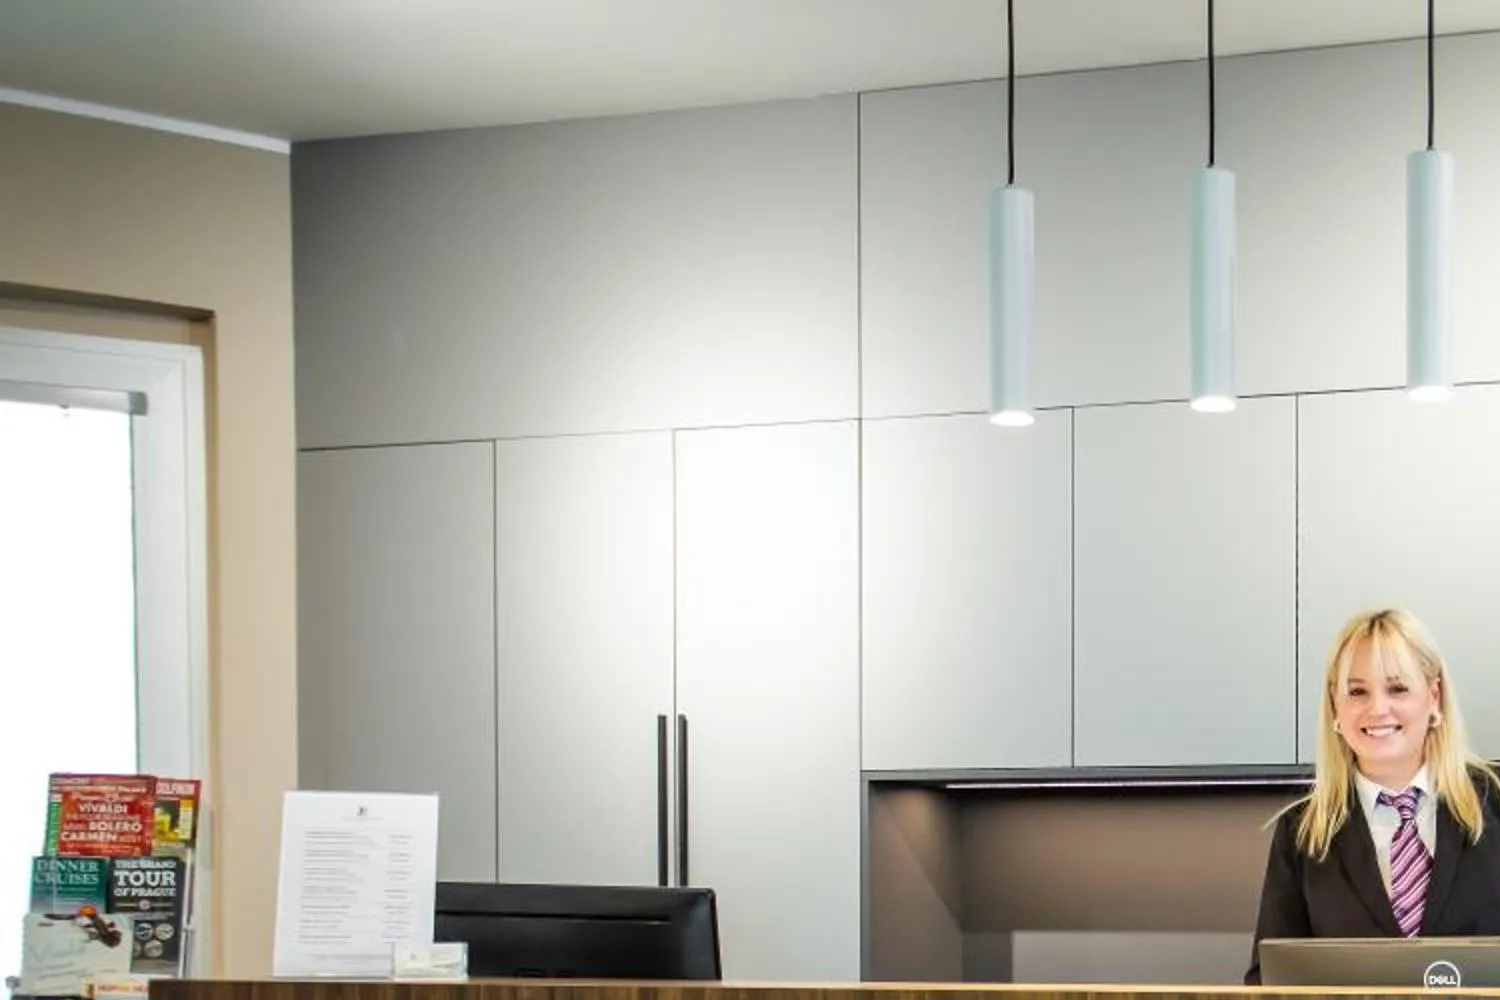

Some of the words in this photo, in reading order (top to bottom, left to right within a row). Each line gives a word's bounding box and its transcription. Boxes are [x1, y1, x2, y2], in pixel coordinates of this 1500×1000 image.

[78, 803, 128, 814] VIVALDI
[89, 821, 142, 832] BOLERO
[61, 832, 117, 842] CARMEN
[37, 860, 99, 872] DINNER
[35, 872, 100, 885] CRUISES
[113, 870, 177, 886] TOUR
[113, 887, 127, 897] OF
[130, 888, 177, 897] PRAGUE
[1429, 975, 1457, 985] DELL
